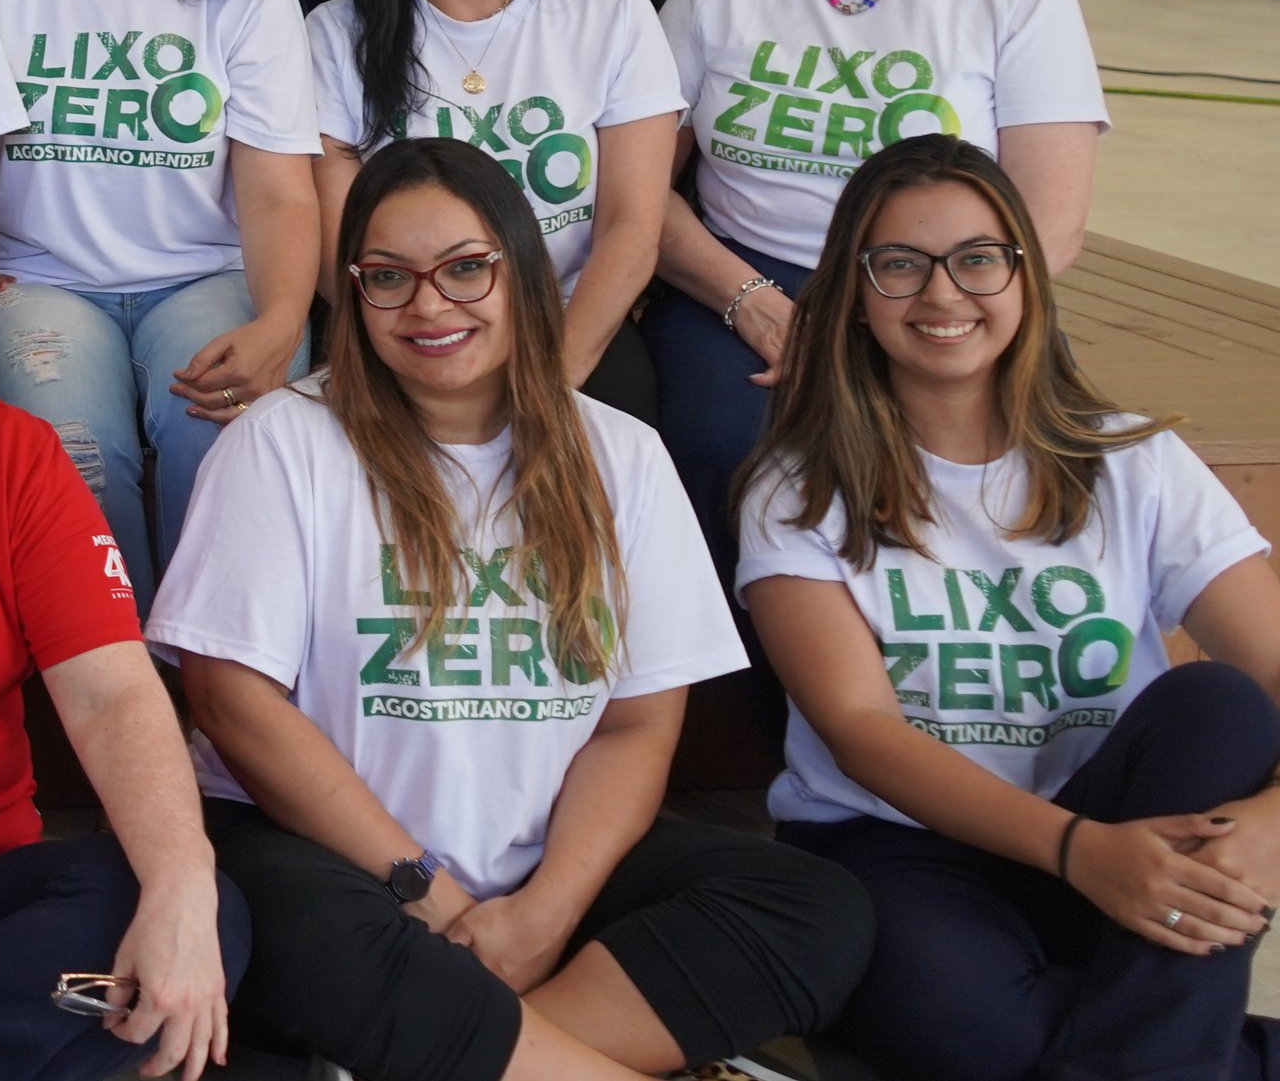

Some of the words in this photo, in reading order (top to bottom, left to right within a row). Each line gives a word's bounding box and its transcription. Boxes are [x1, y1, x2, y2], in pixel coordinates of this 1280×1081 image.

[27, 31, 196, 81] LIXO
[749, 40, 934, 99] LIXO
[6, 72, 223, 143] ZERO
[713, 82, 962, 160] ZERO
[12, 145, 134, 164] AGOSTINIANO
[138, 151, 209, 167] MENDEL
[714, 143, 854, 178] AGOSTINIANO
[540, 208, 588, 234] ENDEL
[884, 566, 1106, 632] LIXO
[356, 595, 616, 686] ZERO
[882, 617, 1135, 713] ZERO
[370, 697, 531, 720] AGOSTINIANO
